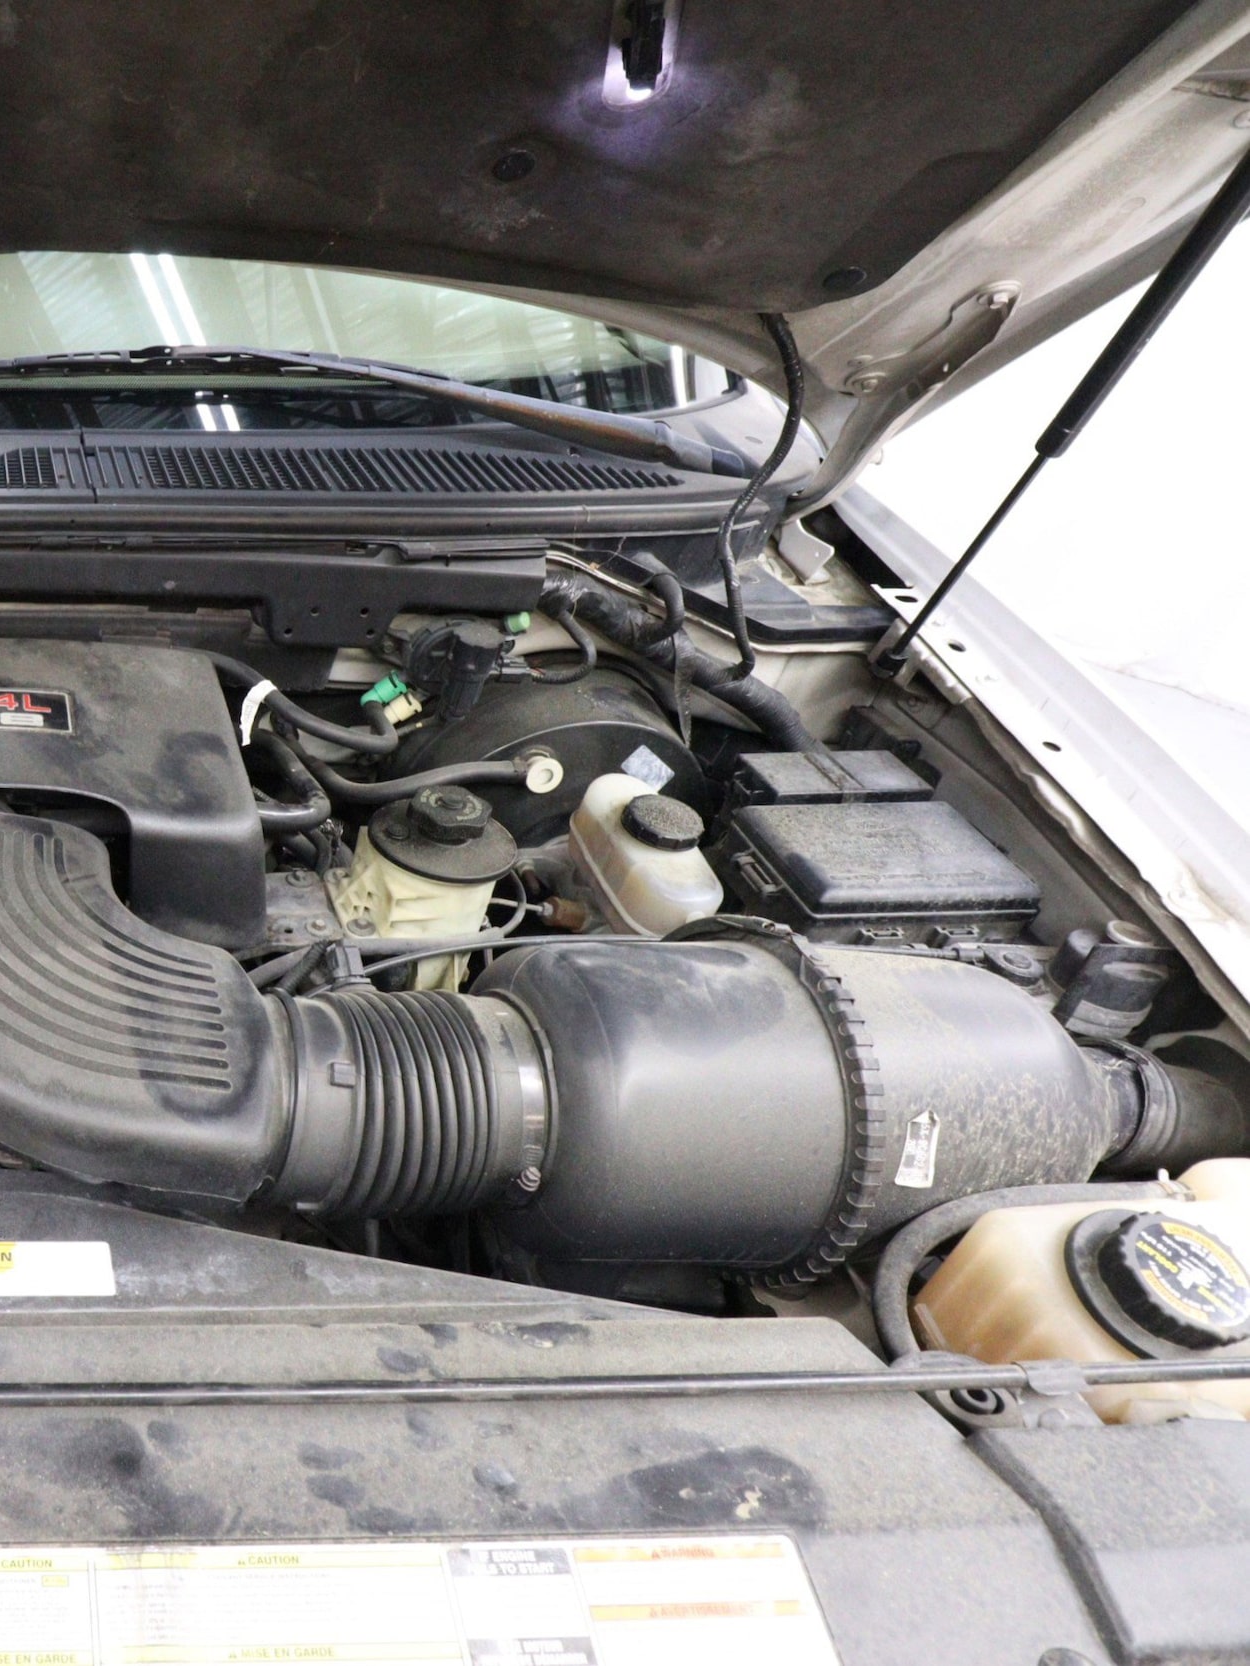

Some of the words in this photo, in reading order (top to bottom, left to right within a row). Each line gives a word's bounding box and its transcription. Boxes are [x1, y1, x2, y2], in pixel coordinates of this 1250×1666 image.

[0, 1559, 53, 1569] CAUTION
[248, 1555, 300, 1566] CAUTION
[501, 1563, 516, 1574] TO
[274, 1648, 290, 1658] EN
[294, 1647, 335, 1658] GARDE
[15, 1654, 32, 1665] EN
[35, 1653, 77, 1665] GARDE
